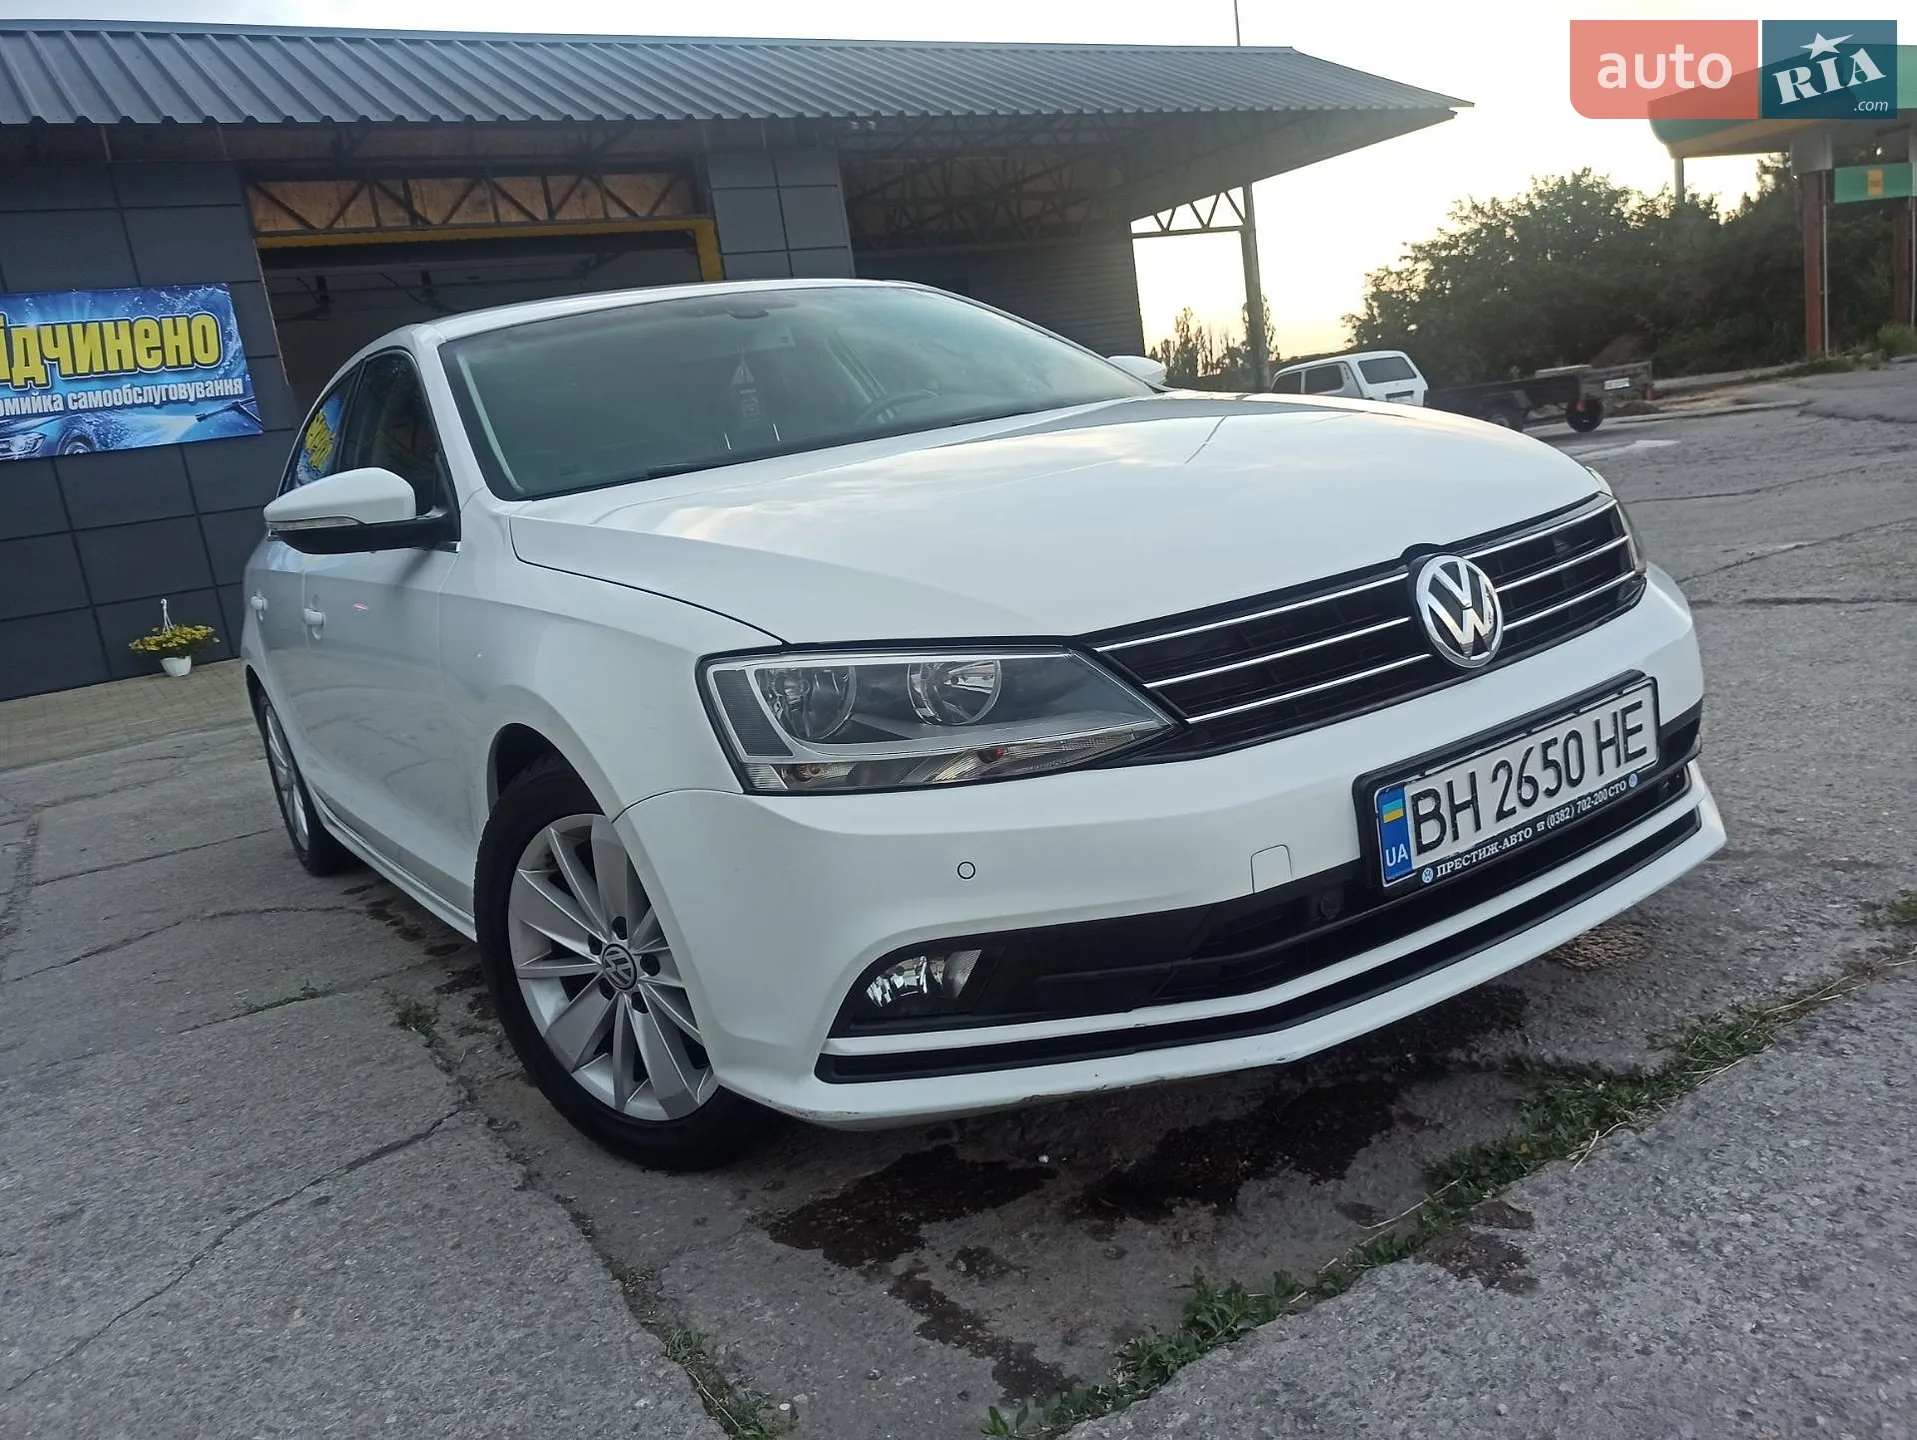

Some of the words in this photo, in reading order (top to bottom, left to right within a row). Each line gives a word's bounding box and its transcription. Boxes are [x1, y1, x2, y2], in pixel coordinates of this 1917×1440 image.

[68, 378, 243, 410] самообслуговування
[1412, 771, 1482, 857] BH
[1490, 729, 1586, 824] 2650
[1594, 699, 1647, 777] HE
[1385, 844, 1409, 868] UA
[1436, 827, 1533, 878] ПРЕСТИЖ-АВТО
[1546, 805, 1574, 829] (0382)
[1608, 780, 1627, 797] СТО
